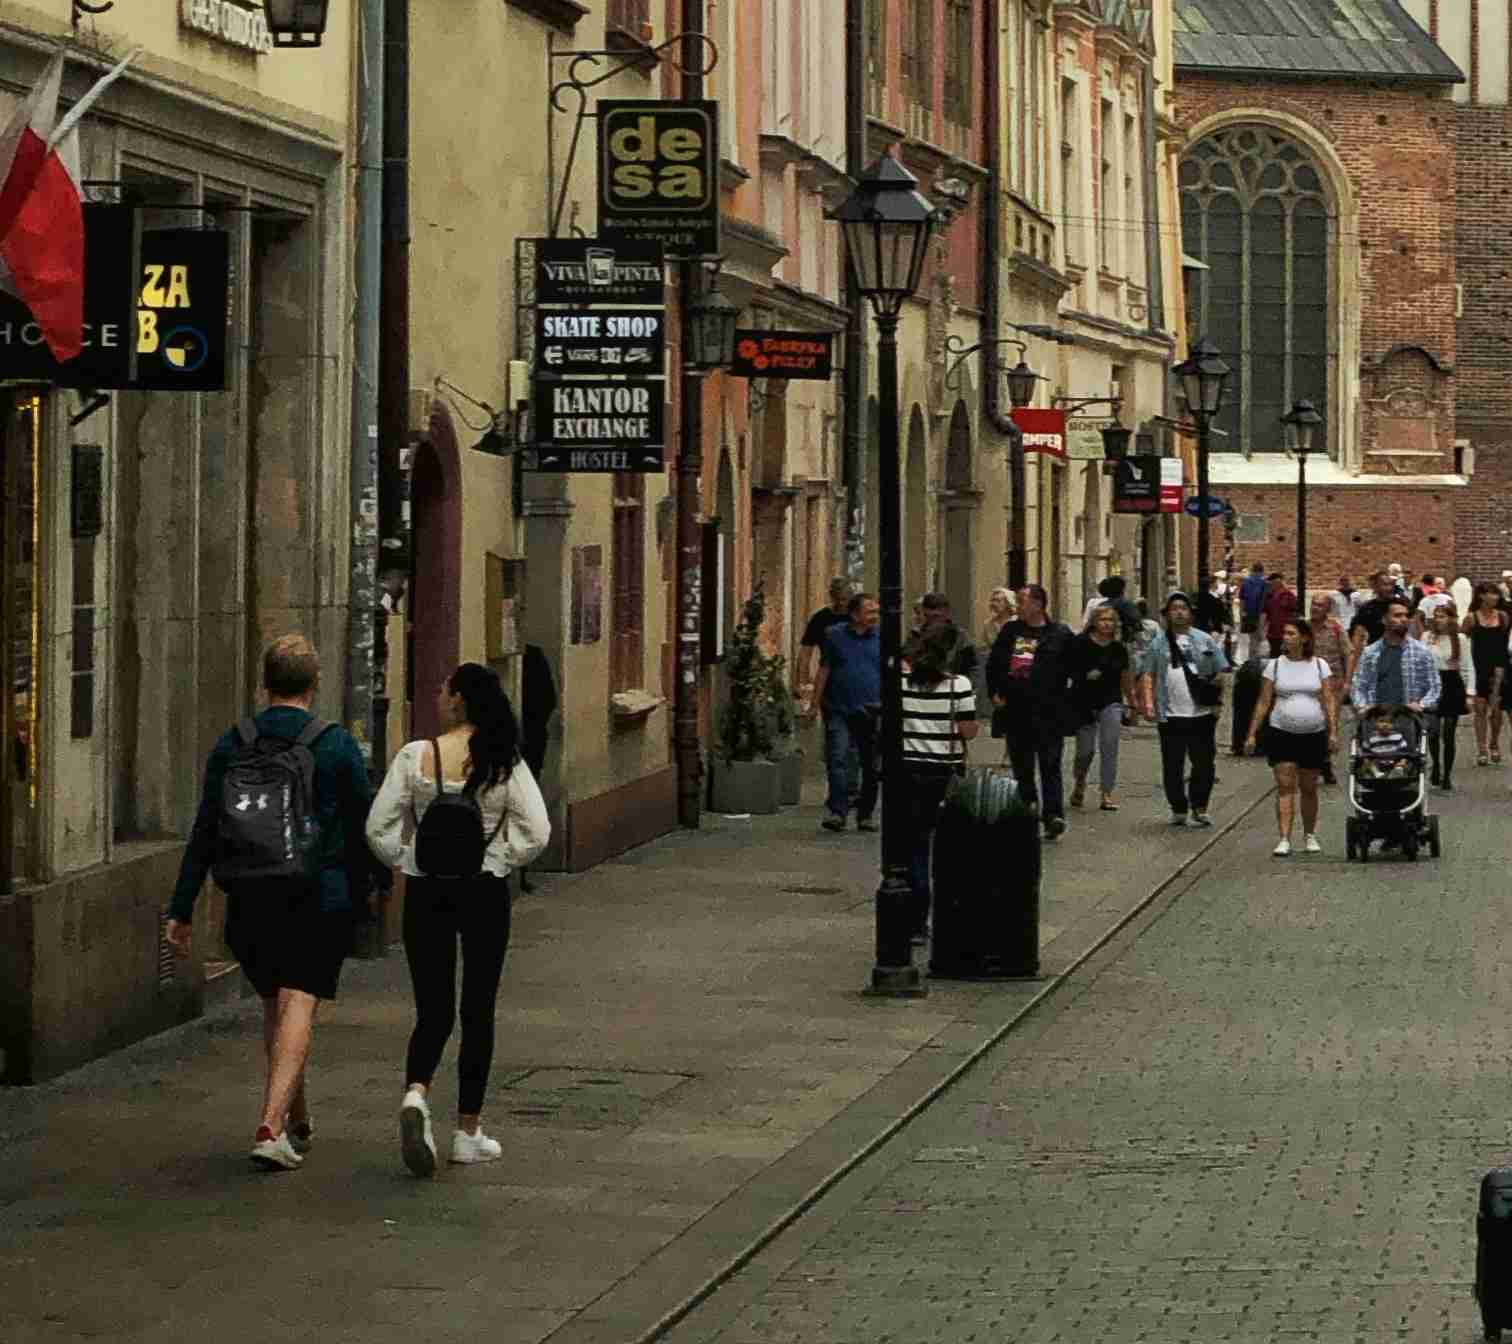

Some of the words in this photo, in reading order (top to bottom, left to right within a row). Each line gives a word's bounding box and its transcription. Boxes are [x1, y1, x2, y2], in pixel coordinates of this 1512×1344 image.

[543, 264, 586, 281] VIVA
[613, 265, 662, 281] PINTA
[137, 264, 191, 308] ZA
[543, 316, 601, 338] SKATE
[605, 316, 658, 338] SHOP
[552, 387, 650, 414] KANTOR
[552, 417, 650, 440] EXCHANGE
[570, 451, 632, 470] HOSTEL
